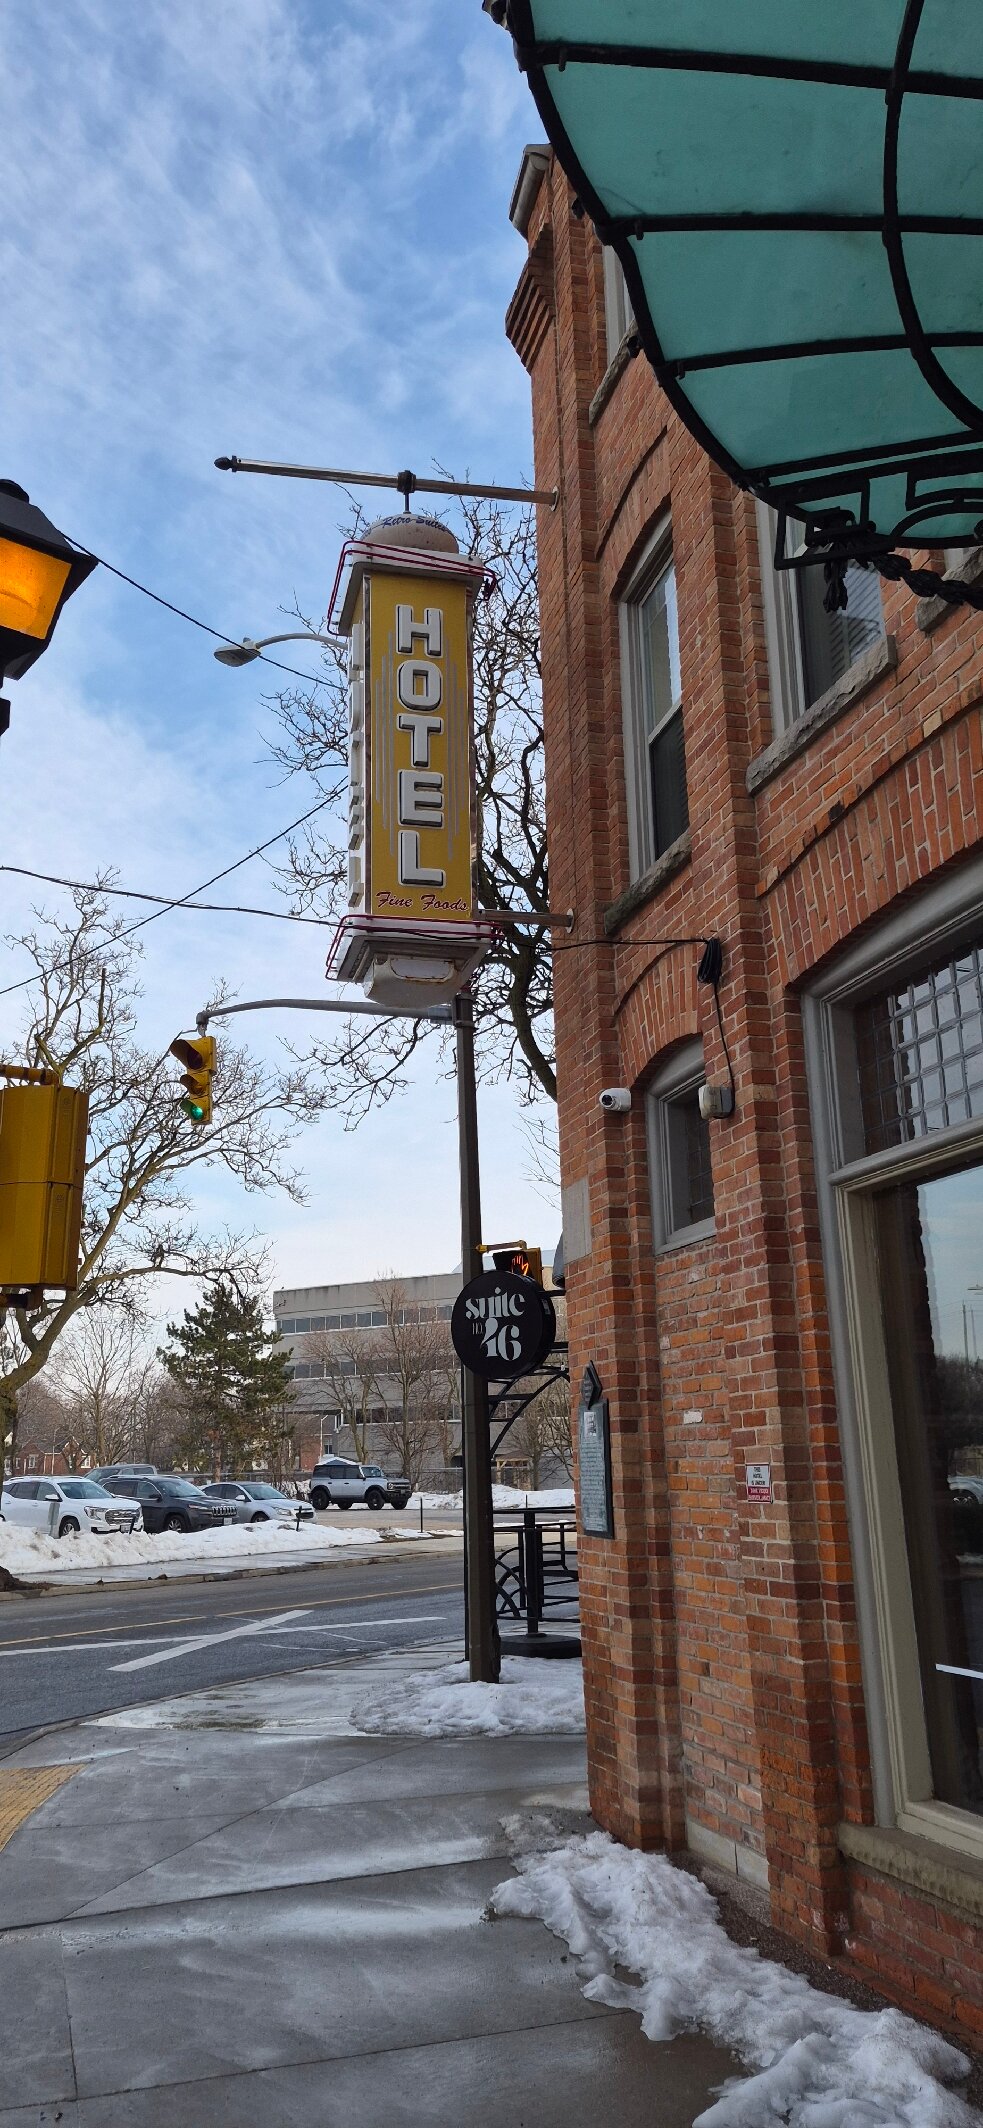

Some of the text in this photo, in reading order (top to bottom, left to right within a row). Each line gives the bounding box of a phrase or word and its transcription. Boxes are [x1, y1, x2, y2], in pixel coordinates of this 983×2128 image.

[382, 516, 411, 529] Retro
[396, 604, 446, 888] HOTEL
[376, 891, 468, 911] Fine Foods
[465, 1287, 525, 1320] suite
